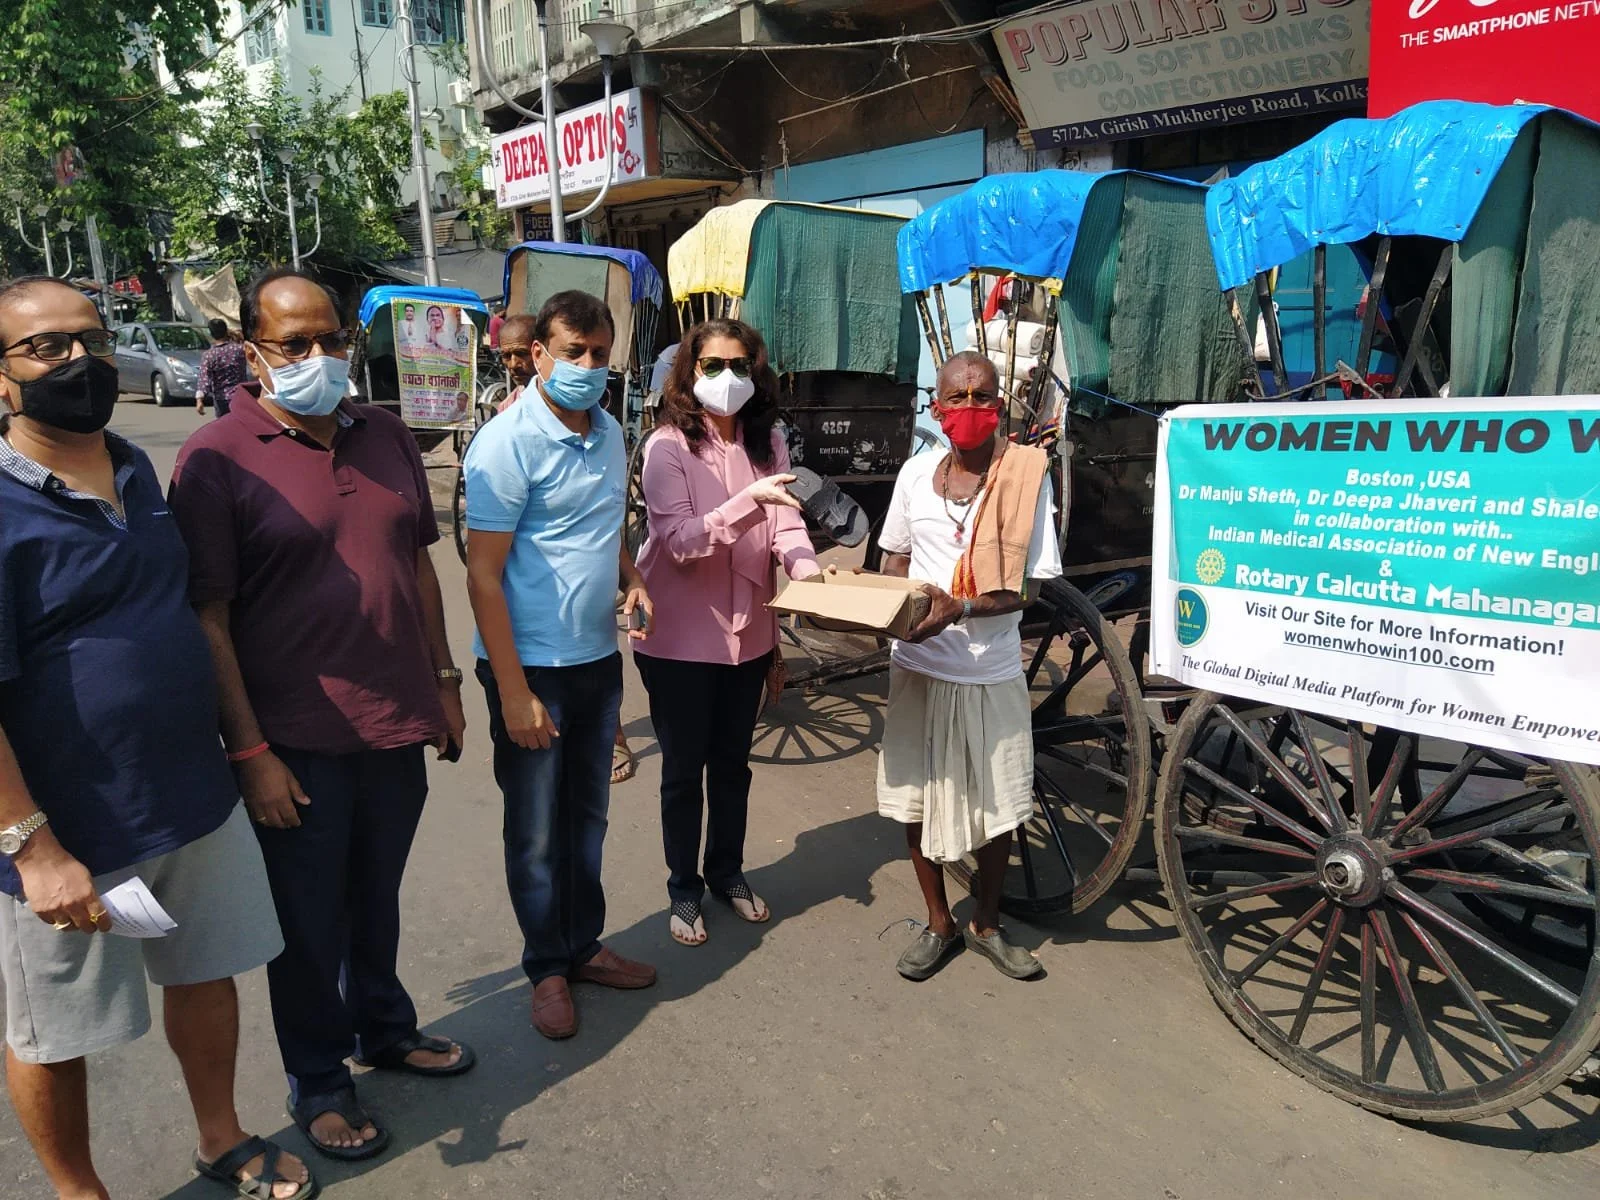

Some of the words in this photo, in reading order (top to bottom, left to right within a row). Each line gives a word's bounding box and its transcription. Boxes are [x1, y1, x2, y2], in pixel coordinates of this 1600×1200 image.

[1004, 0, 1227, 72] POPULAR
[1400, 30, 1429, 48] THE
[1433, 8, 1550, 43] SMARTPHONE
[1053, 60, 1133, 93] FOOD,
[1137, 41, 1211, 77] SOFT
[1219, 14, 1352, 62] DRINKS
[1100, 49, 1355, 113] CONFECTIONERY
[1052, 126, 1099, 143] 57/2A,
[1100, 113, 1149, 136] Girish
[1153, 104, 1247, 129] Mukherjee
[1251, 92, 1309, 114] Road,
[502, 129, 561, 183] DEEPA
[821, 420, 851, 434] 4267
[1203, 420, 1392, 452] WOMEN
[1405, 418, 1550, 453] WHO
[1346, 469, 1414, 487] Boston
[1178, 485, 1197, 500] Dr
[1200, 486, 1243, 505] Manju
[1247, 487, 1300, 507] Sheth,
[1307, 489, 1329, 506] Dr
[1332, 490, 1393, 511] Deepa
[1399, 492, 1477, 513] Jhaveri
[1483, 497, 1525, 515] and
[1531, 497, 1600, 520] Shale
[1293, 510, 1310, 526] in
[1314, 512, 1446, 535] collaboration
[1452, 520, 1513, 540] with..
[1208, 525, 1255, 544] Indian
[1259, 529, 1324, 549] Medical
[1328, 533, 1446, 559] Association
[1453, 543, 1477, 561] of
[1482, 545, 1535, 567] New
[1541, 549, 1600, 575] Engl
[1378, 559, 1393, 578] &
[1235, 564, 1309, 596] Rotary
[1316, 572, 1416, 604] Calcutta
[1245, 601, 1277, 619] Visit
[1281, 606, 1310, 623] Our
[1313, 610, 1346, 628] Site
[1351, 615, 1374, 632] for
[1379, 619, 1422, 640] More
[1429, 626, 1565, 656] Information!
[1284, 630, 1495, 673] womenwhowin100.com
[1182, 655, 1200, 670] The
[1203, 660, 1241, 678] Global
[1244, 667, 1289, 687] Digital
[1292, 676, 1337, 696] Media
[1341, 685, 1404, 708] Platform
[1406, 698, 1437, 716] for
[1442, 702, 1506, 727] Women
